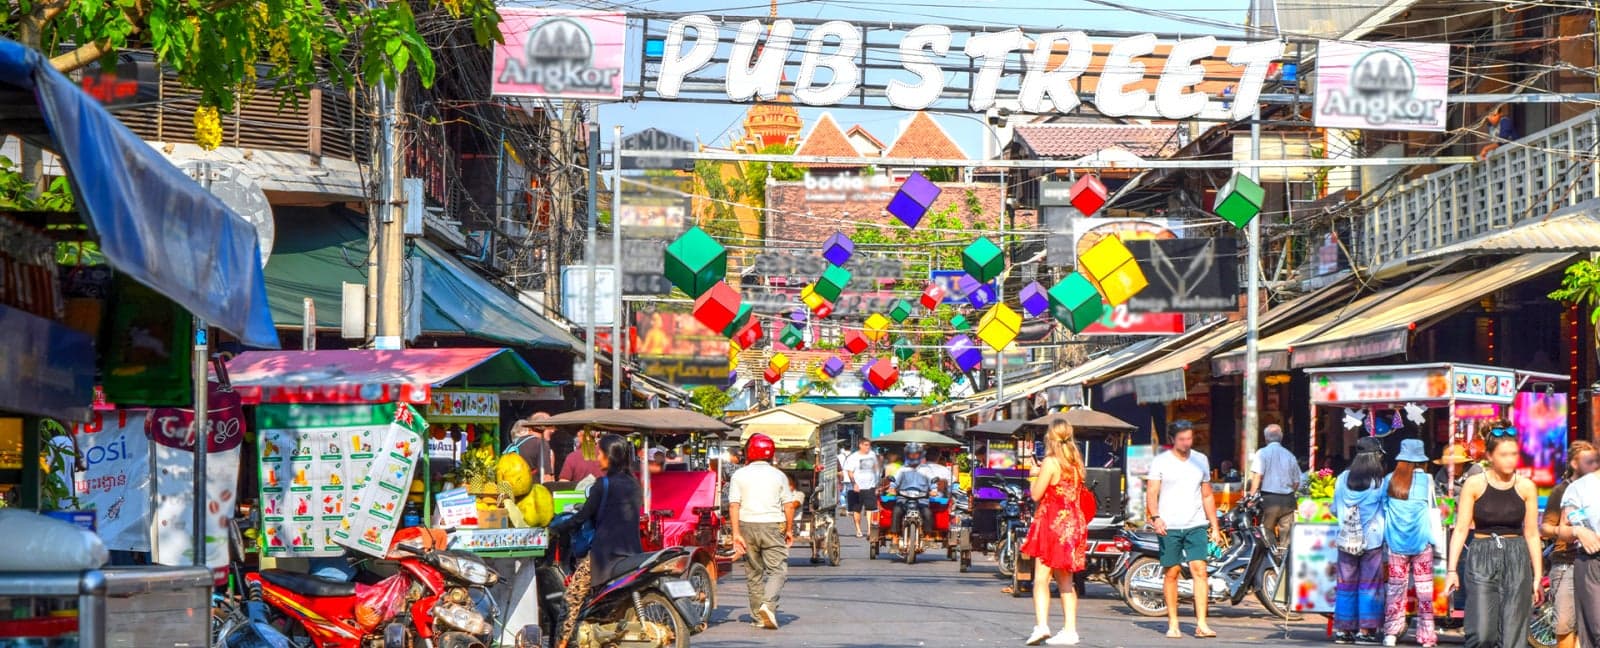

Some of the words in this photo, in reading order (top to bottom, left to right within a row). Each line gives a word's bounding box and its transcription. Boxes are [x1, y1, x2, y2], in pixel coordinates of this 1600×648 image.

[498, 58, 620, 92] Angkor
[656, 14, 863, 105] PUB
[886, 24, 1286, 121] STREET
[1321, 88, 1443, 125] Angkor
